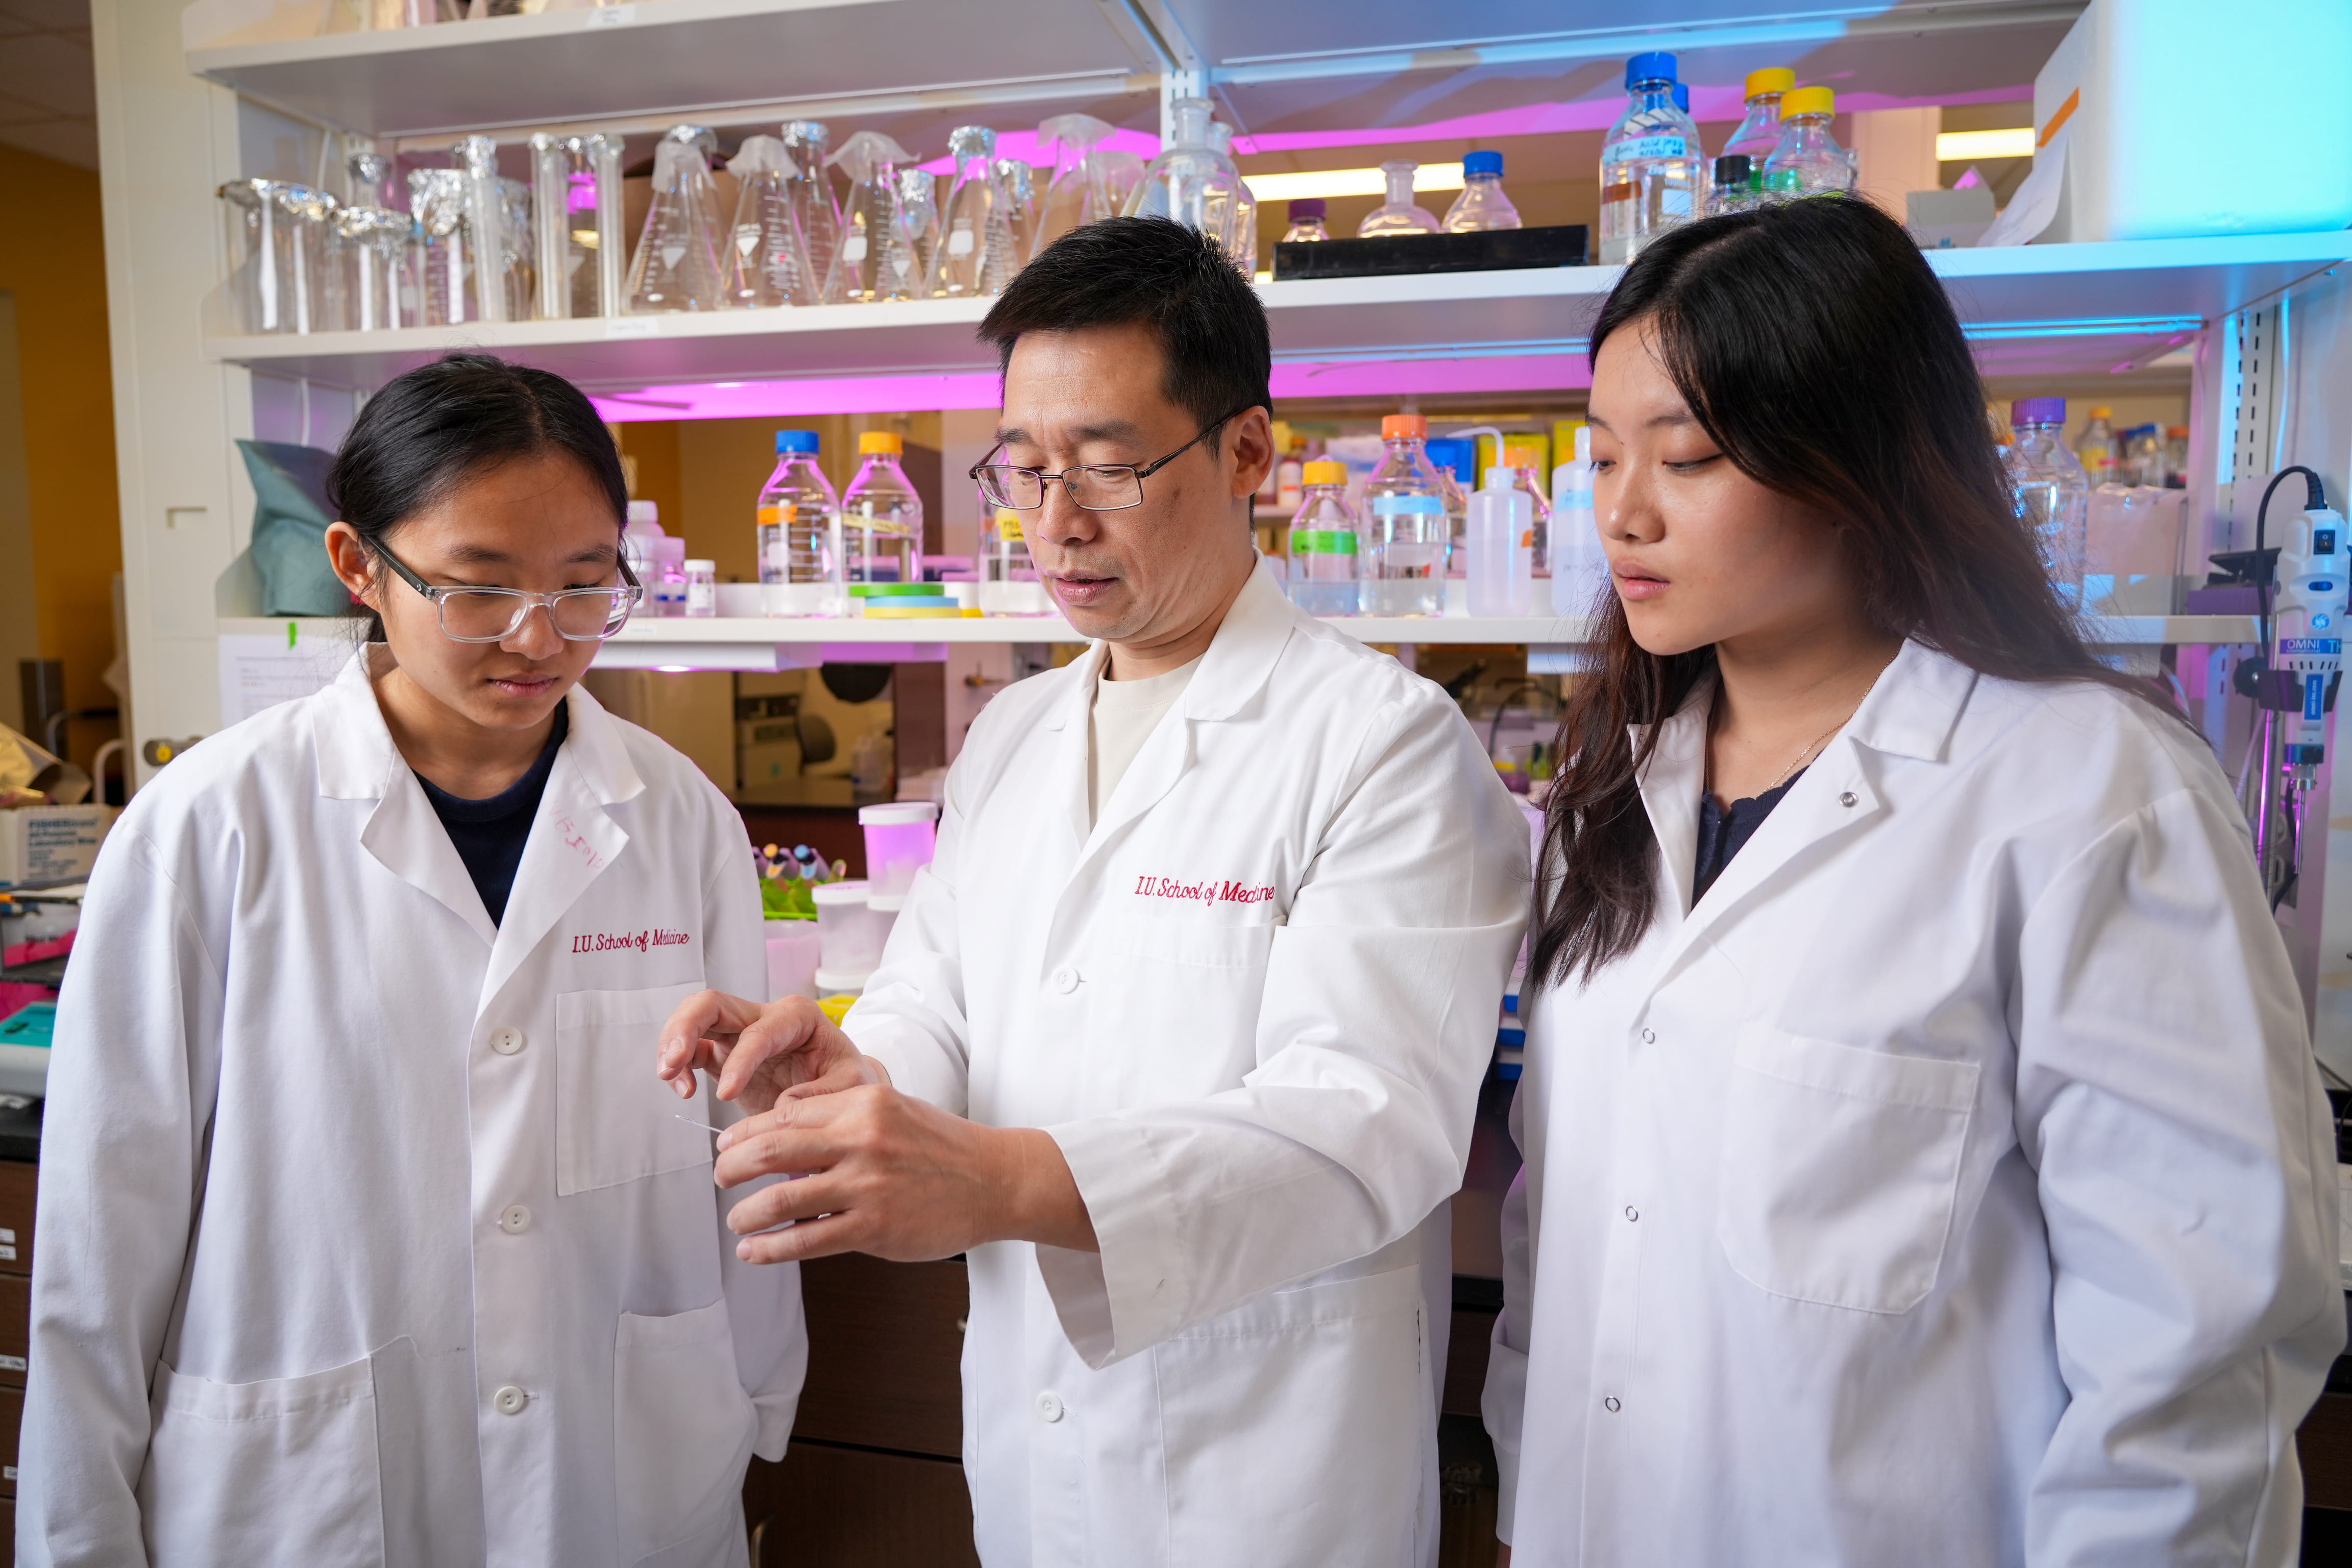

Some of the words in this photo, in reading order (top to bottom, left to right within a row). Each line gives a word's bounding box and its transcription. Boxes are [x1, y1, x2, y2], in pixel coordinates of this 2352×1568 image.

[2287, 639, 2320, 649] OMNI
[1134, 876, 1157, 896] I.U.
[1157, 878, 1203, 899] School
[1205, 881, 1218, 906] of
[572, 936, 594, 953] I.U.
[596, 932, 633, 950] School
[635, 930, 649, 952] of
